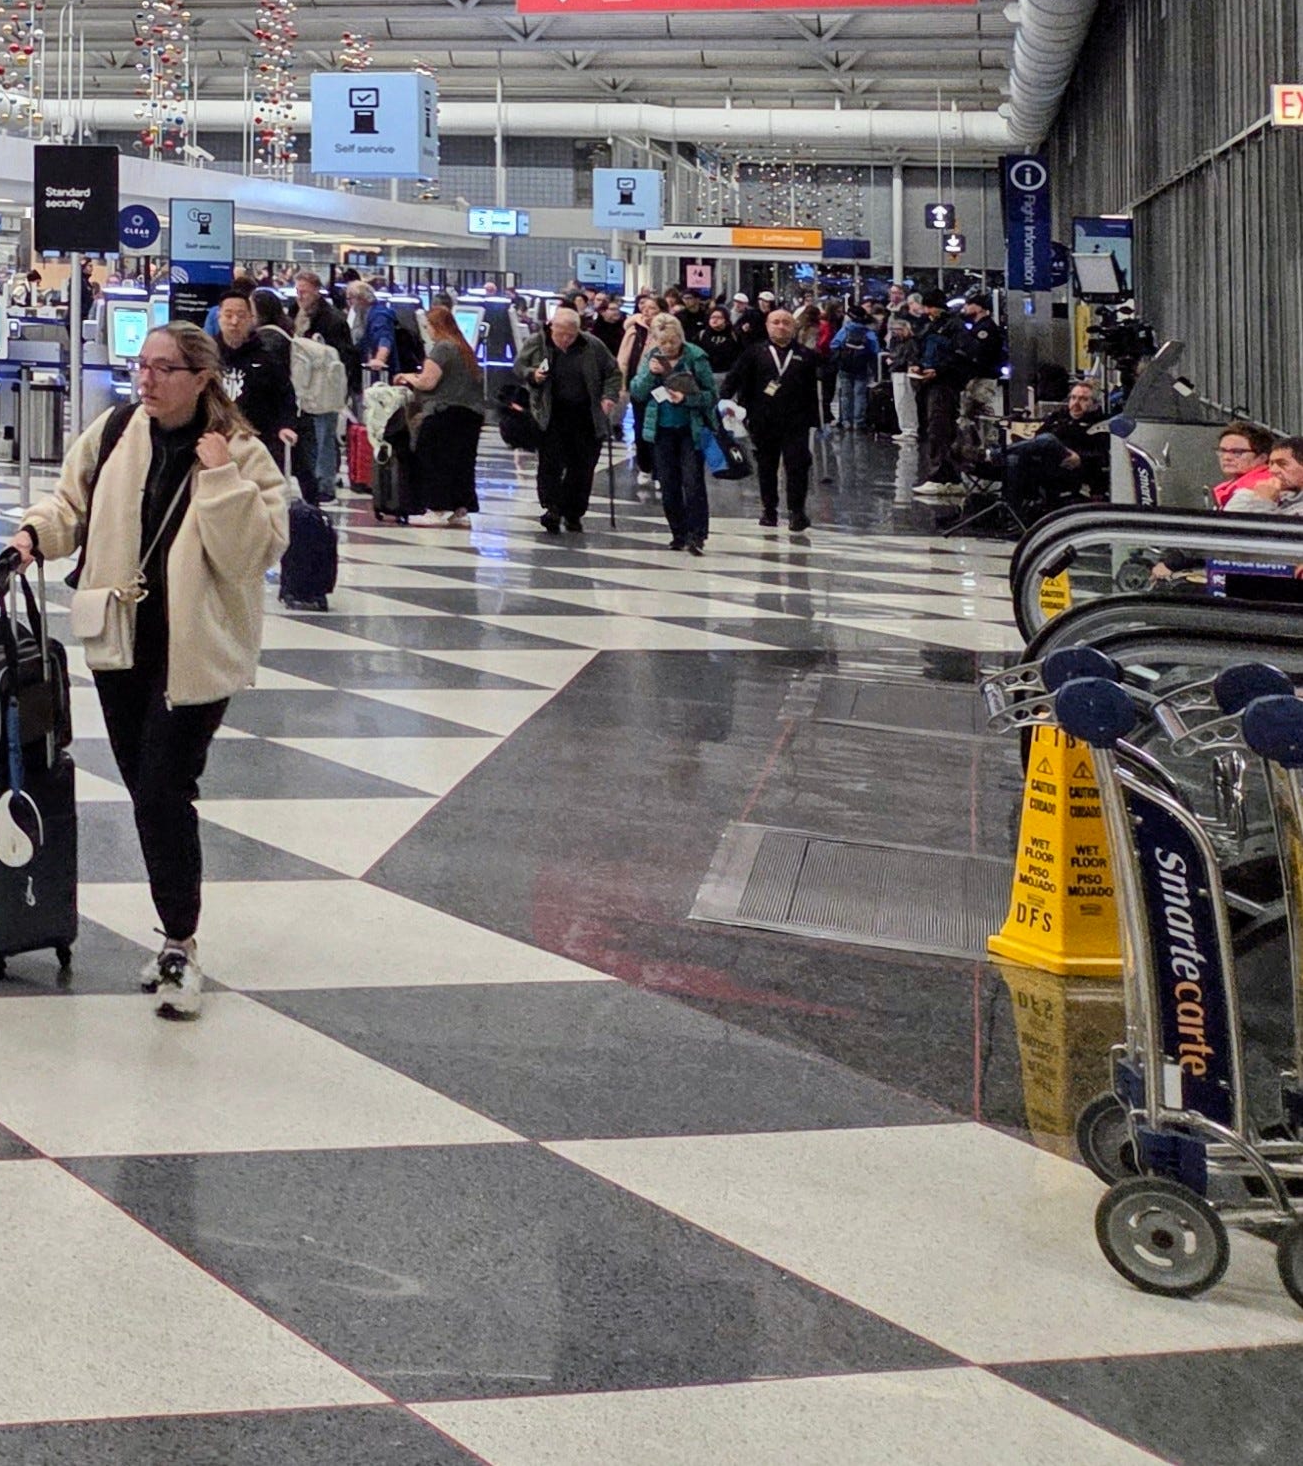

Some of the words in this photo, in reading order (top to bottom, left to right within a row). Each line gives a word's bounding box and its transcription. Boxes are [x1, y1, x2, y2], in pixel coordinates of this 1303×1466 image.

[334, 143, 355, 154] Self
[357, 145, 395, 154] service
[45, 187, 91, 198] Standard
[45, 200, 85, 210] security
[1020, 194, 1036, 222] Flight
[1024, 225, 1036, 285] Information
[1030, 836, 1050, 850] WET
[1025, 846, 1054, 863] FLOOR
[1075, 844, 1099, 855] WET
[1071, 857, 1107, 868] FLOOR
[1028, 865, 1049, 879] PISO
[1019, 873, 1056, 893] MOJADO
[1077, 874, 1102, 885] PISO
[1068, 886, 1114, 897] MOJADO
[1155, 847, 1215, 1076] smartecarte
